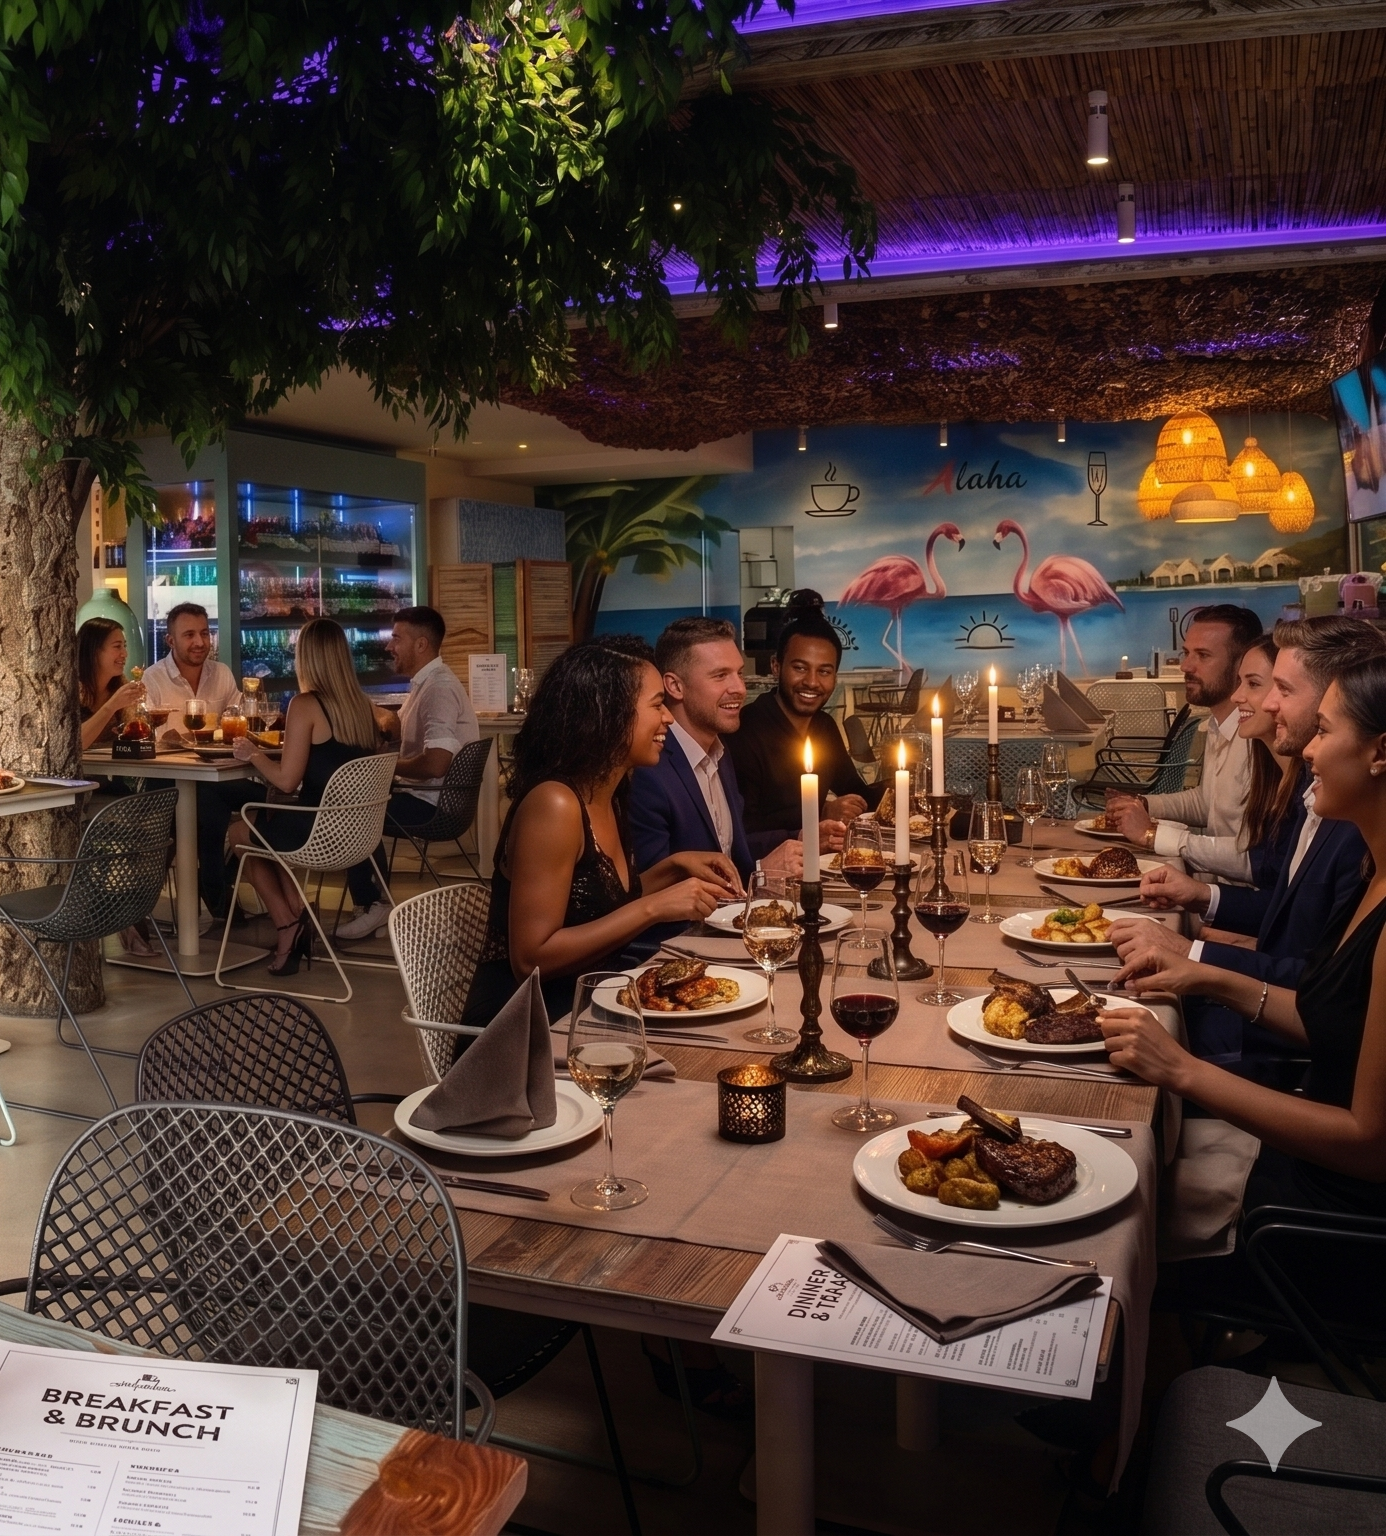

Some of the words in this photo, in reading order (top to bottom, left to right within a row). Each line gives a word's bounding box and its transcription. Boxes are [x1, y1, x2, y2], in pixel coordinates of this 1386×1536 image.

[41, 1387, 235, 1420] BREAKFAST
[43, 1409, 66, 1426] &
[75, 1412, 221, 1442] BRUNCH
